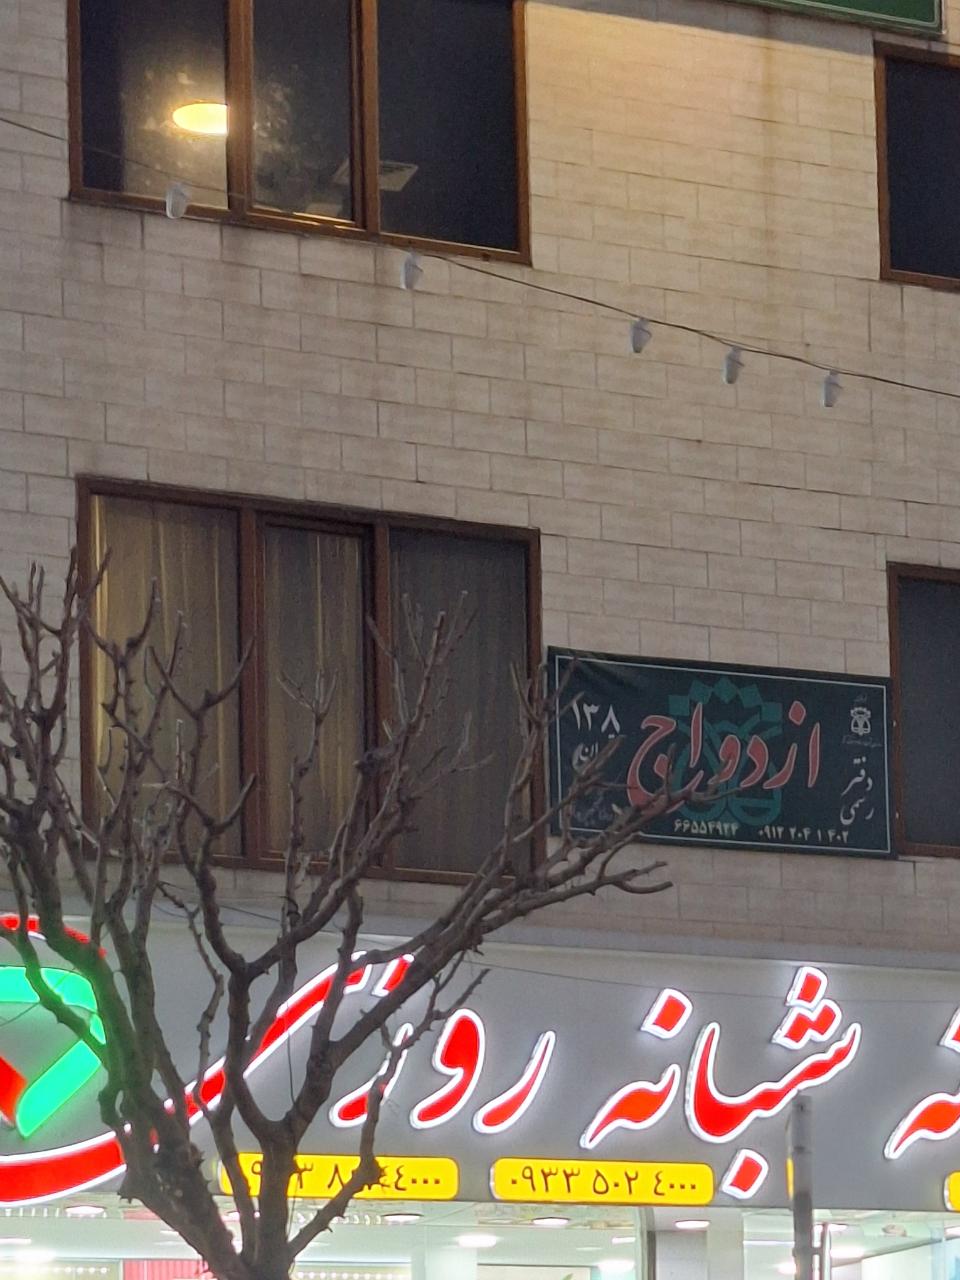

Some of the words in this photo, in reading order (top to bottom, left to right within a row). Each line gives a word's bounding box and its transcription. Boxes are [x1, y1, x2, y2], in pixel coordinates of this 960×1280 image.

[571, 699, 621, 733] ۱۳۸
[626, 700, 821, 815] ازدواج
[841, 756, 873, 796] دفتر
[840, 798, 875, 826] رسمی
[579, 965, 863, 1200] شبانه
